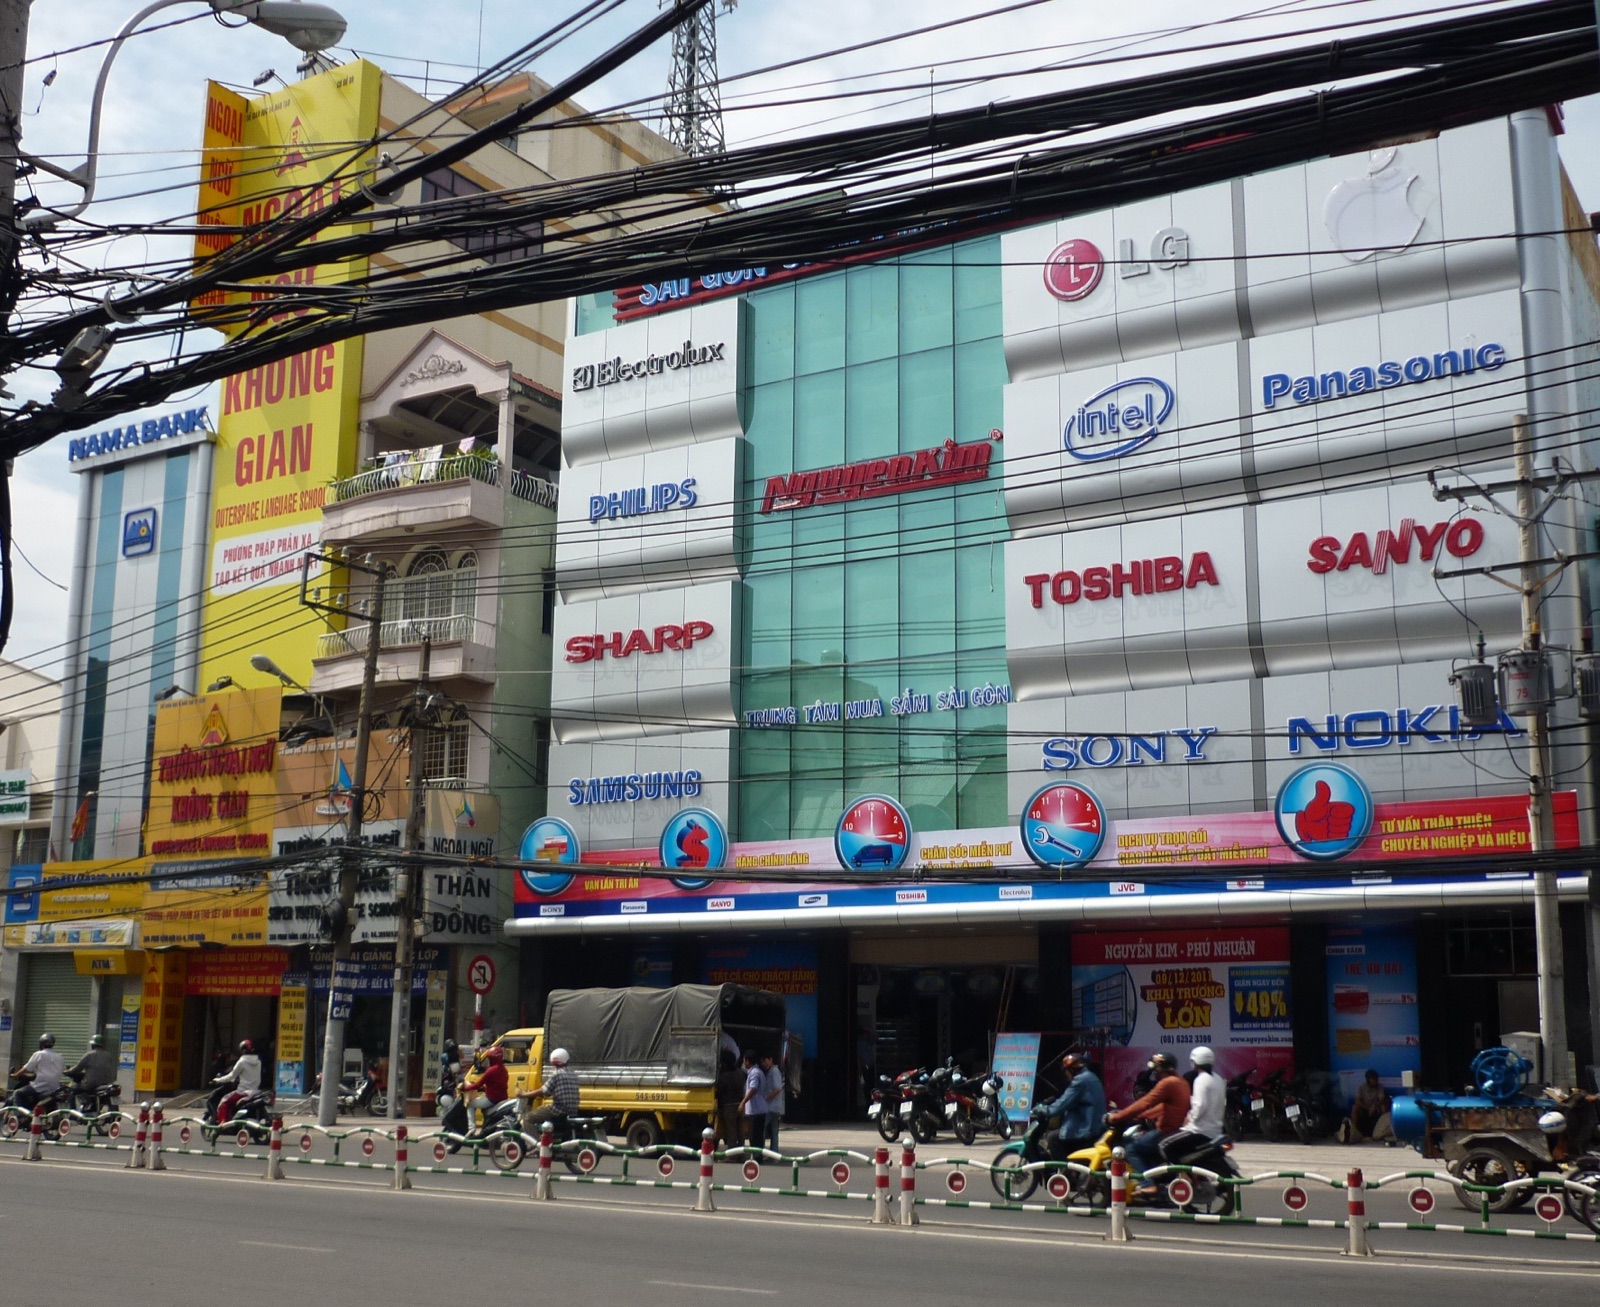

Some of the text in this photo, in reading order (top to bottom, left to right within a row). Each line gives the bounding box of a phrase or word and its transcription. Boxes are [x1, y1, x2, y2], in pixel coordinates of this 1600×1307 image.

[207, 97, 243, 146] NGOẠI
[1119, 226, 1190, 280] LG
[597, 340, 725, 387] Electrolux
[1262, 342, 1506, 408] Panasonic
[1076, 392, 1156, 438] intel
[235, 423, 313, 487] GIAN
[216, 487, 326, 529] OUTERSPACE LANGUAGE SCHOOL
[589, 478, 697, 523] PHILIPS
[1307, 518, 1484, 574] SANYO
[1023, 551, 1219, 609] TOSHIBA
[564, 620, 713, 663] SHARP
[743, 707, 799, 727] TRUNG
[803, 700, 841, 724] TÂM
[845, 699, 885, 720] MUA
[936, 686, 968, 711] SÀI
[970, 681, 1013, 707] GÒN
[1041, 726, 1218, 772] SONY
[569, 769, 703, 806] SAMSUNG
[867, 803, 874, 811] 12
[883, 806, 887, 814] 1
[1042, 797, 1049, 805] 11
[1086, 803, 1091, 811] 2
[1032, 811, 1040, 819] 10
[1092, 819, 1097, 827] 3
[1380, 817, 1397, 834] TƯ
[1397, 815, 1421, 831] VẤN
[949, 843, 968, 859] SÓC
[969, 841, 993, 858] MIỄN
[995, 841, 1013, 857] PHÍ
[1118, 833, 1142, 849] DỊCH
[1159, 831, 1187, 847] TRỌN
[1189, 828, 1208, 844] GÓI
[1381, 835, 1429, 852] CHUYÊN
[1431, 831, 1475, 851] NGHIỆP
[1477, 830, 1494, 847] VÀ
[1496, 829, 1525, 846] HIỆU
[759, 853, 785, 867] CHÍNH
[434, 867, 490, 898] THẦN
[615, 880, 627, 889] TRI
[627, 877, 639, 889] ÂN
[1000, 888, 1030, 897] Electrolux
[1118, 884, 1135, 892] JVC
[897, 892, 925, 900] TOSHIBA
[433, 904, 491, 934] ĐỒNG
[1155, 943, 1177, 958] KIM
[1187, 938, 1211, 957] PHÚ
[1214, 937, 1256, 959] NHUẬN
[1146, 987, 1174, 1002] KHAI
[1164, 1002, 1212, 1029] LỚN
[1160, 1035, 1174, 1045] (08)
[1176, 1035, 1192, 1044] 6252
